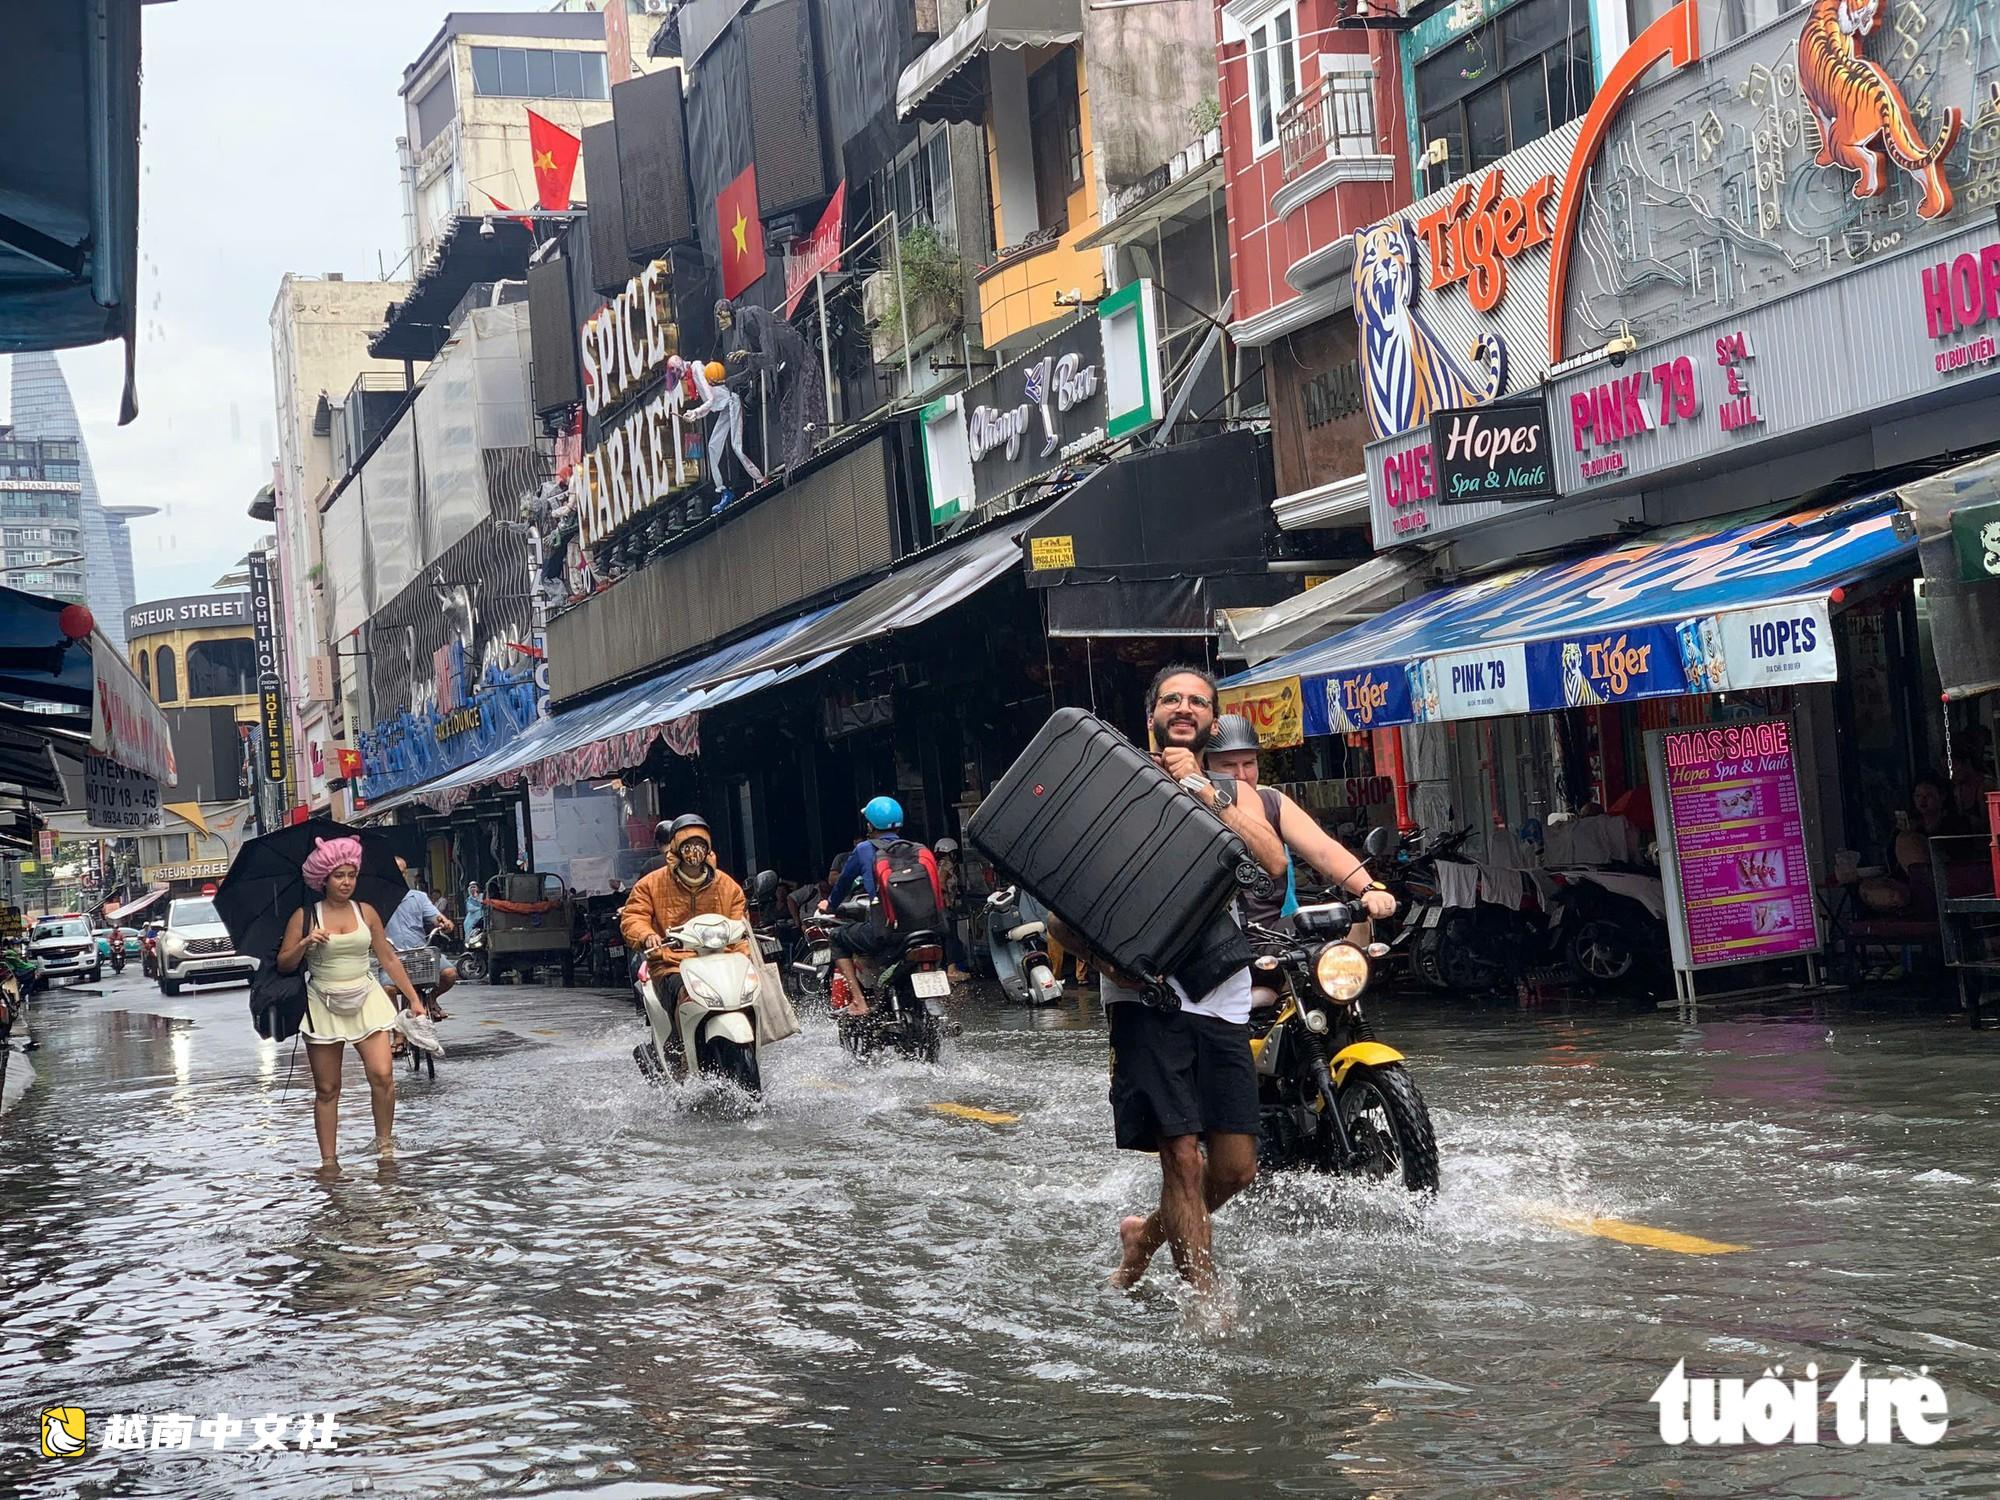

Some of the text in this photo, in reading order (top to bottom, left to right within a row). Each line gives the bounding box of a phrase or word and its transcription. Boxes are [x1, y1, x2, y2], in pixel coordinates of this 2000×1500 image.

[1419, 169, 1555, 313] Tiger
[581, 260, 672, 416] SPICE
[1715, 331, 1752, 366] SPA
[1935, 335, 1997, 373] 81 BÙI VIỆN
[1052, 353, 1097, 412] Bar
[1727, 367, 1746, 395] &
[1569, 371, 1653, 452] PINK
[1652, 356, 1702, 426] 79
[1719, 394, 1762, 432] NAIL
[1446, 416, 1541, 471] Hopes
[573, 382, 688, 549] MARKET
[1449, 465, 1546, 498] Spa & Nails
[1580, 450, 1623, 479] 79 BÙI VIỆN
[0, 482, 14, 490] EN
[130, 601, 244, 629] PASTEUR STREET
[253, 567, 273, 673] LIGHTHO
[1749, 616, 1817, 659] HOPES
[1451, 660, 1506, 695] PINK 79
[1587, 633, 1651, 696] Tiger
[266, 693, 278, 737] HOTEL
[1343, 672, 1389, 725] Tiger
[1666, 722, 1789, 766] MASSAGE
[1671, 753, 1789, 787] Hopes Spa & Nails
[119, 788, 132, 808] 18
[142, 788, 157, 809] 45
[1345, 776, 1393, 806] SHOP
[103, 809, 122, 824] 0934
[123, 812, 140, 825] 620
[142, 812, 161, 826] 748
[152, 863, 229, 881] PASTEUR STREE
